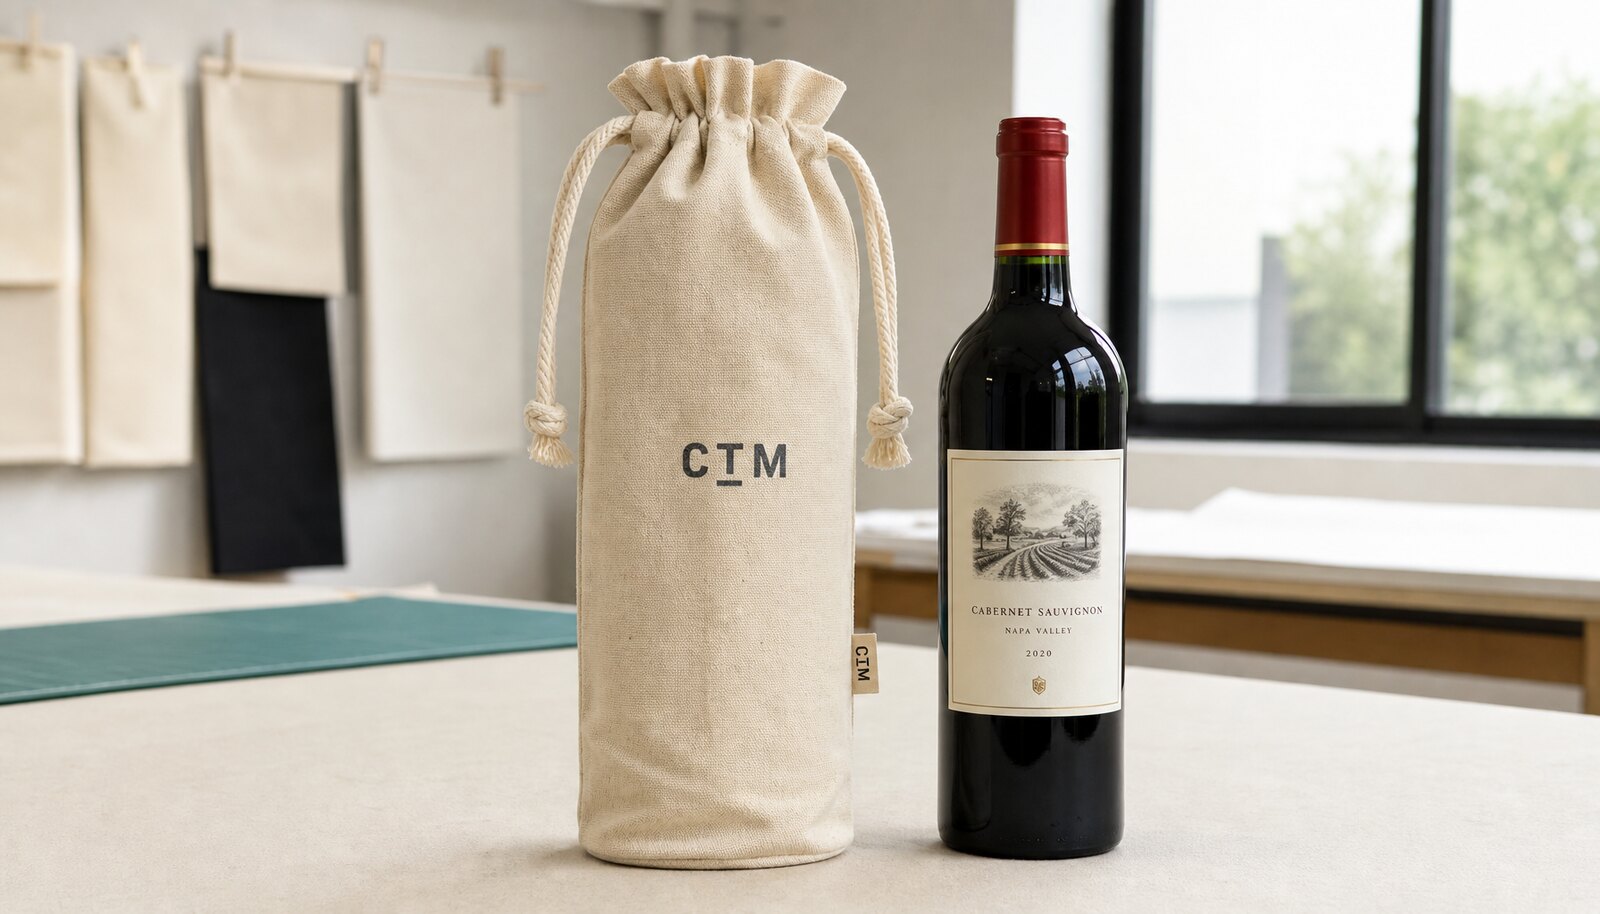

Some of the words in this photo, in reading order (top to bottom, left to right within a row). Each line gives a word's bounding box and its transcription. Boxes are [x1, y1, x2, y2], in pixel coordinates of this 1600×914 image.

[682, 442, 787, 486] CTM
[971, 605, 1032, 617] CABERNET
[1037, 605, 1103, 617] SAUVIGNON
[1005, 627, 1031, 635] NAPA
[1036, 627, 1072, 635] VALLEY
[1026, 649, 1052, 658] 2020
[855, 646, 870, 681] CTM
